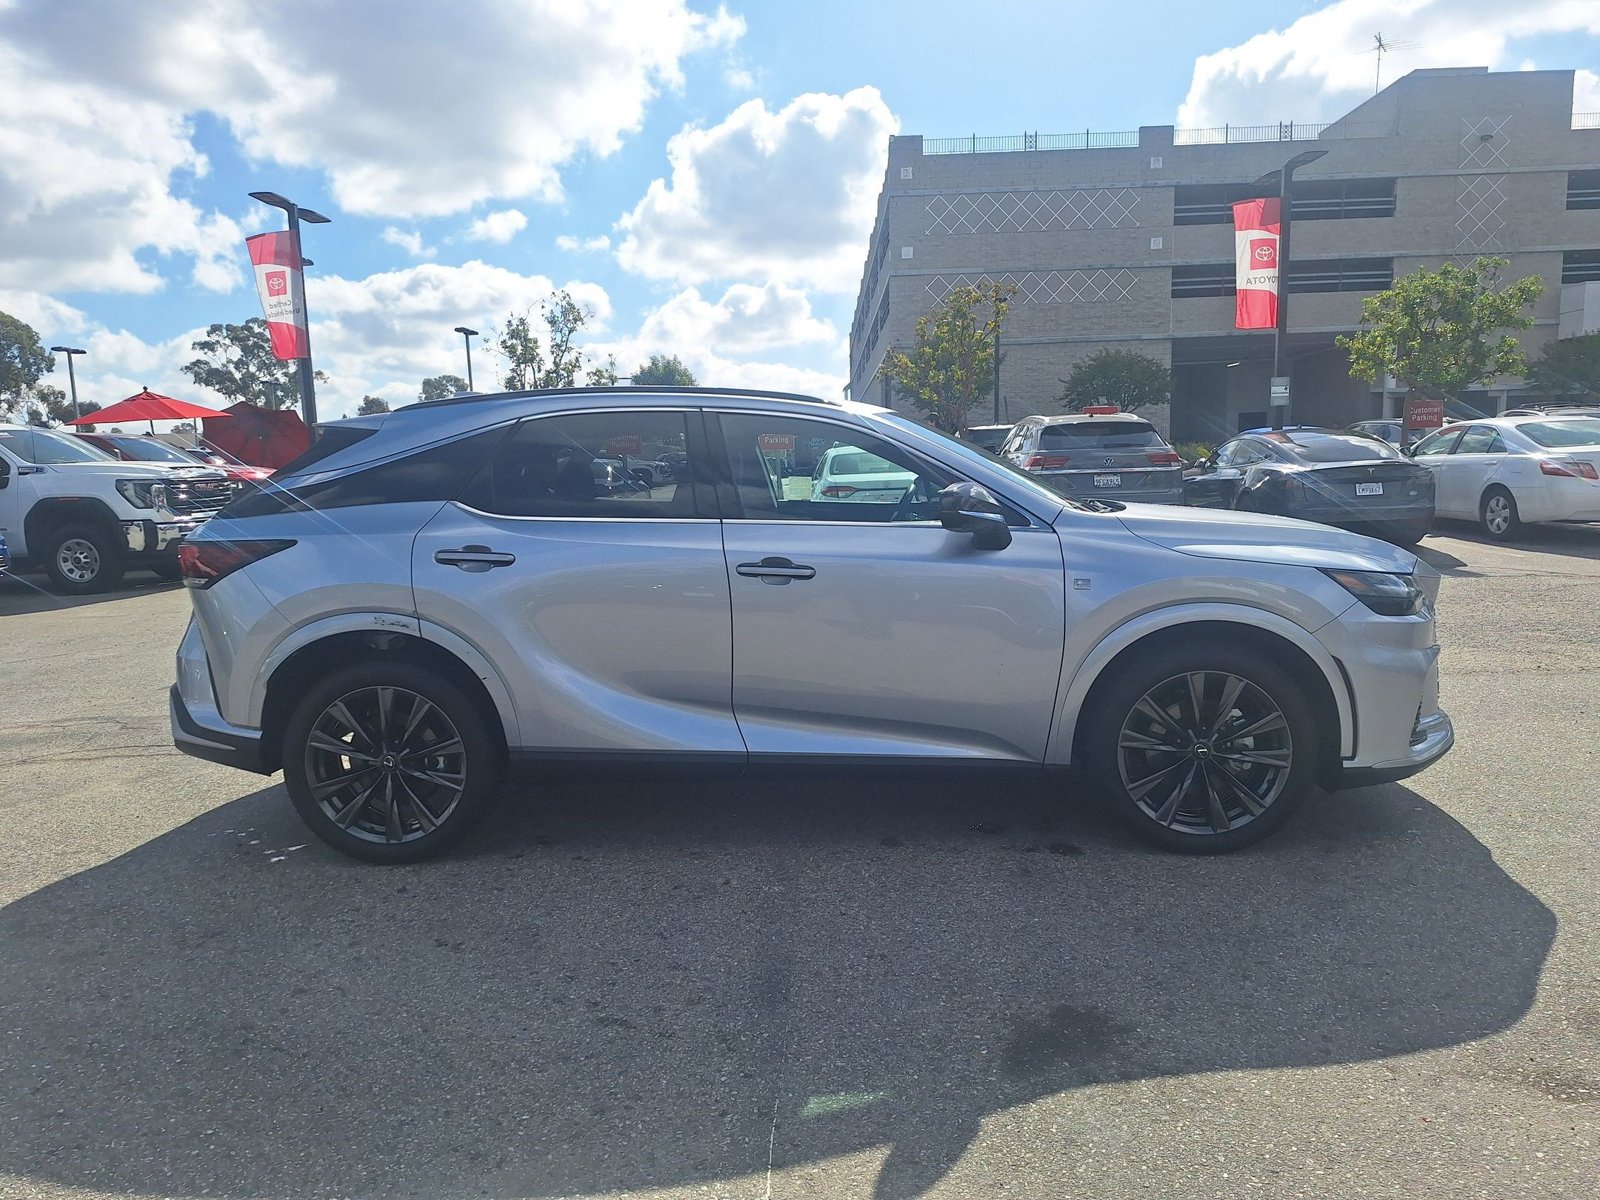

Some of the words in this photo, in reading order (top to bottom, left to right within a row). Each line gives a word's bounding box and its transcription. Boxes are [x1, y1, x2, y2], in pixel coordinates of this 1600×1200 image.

[1410, 406, 1441, 414] Customer
[1411, 414, 1438, 422] Parking
[764, 435, 789, 444] Parking
